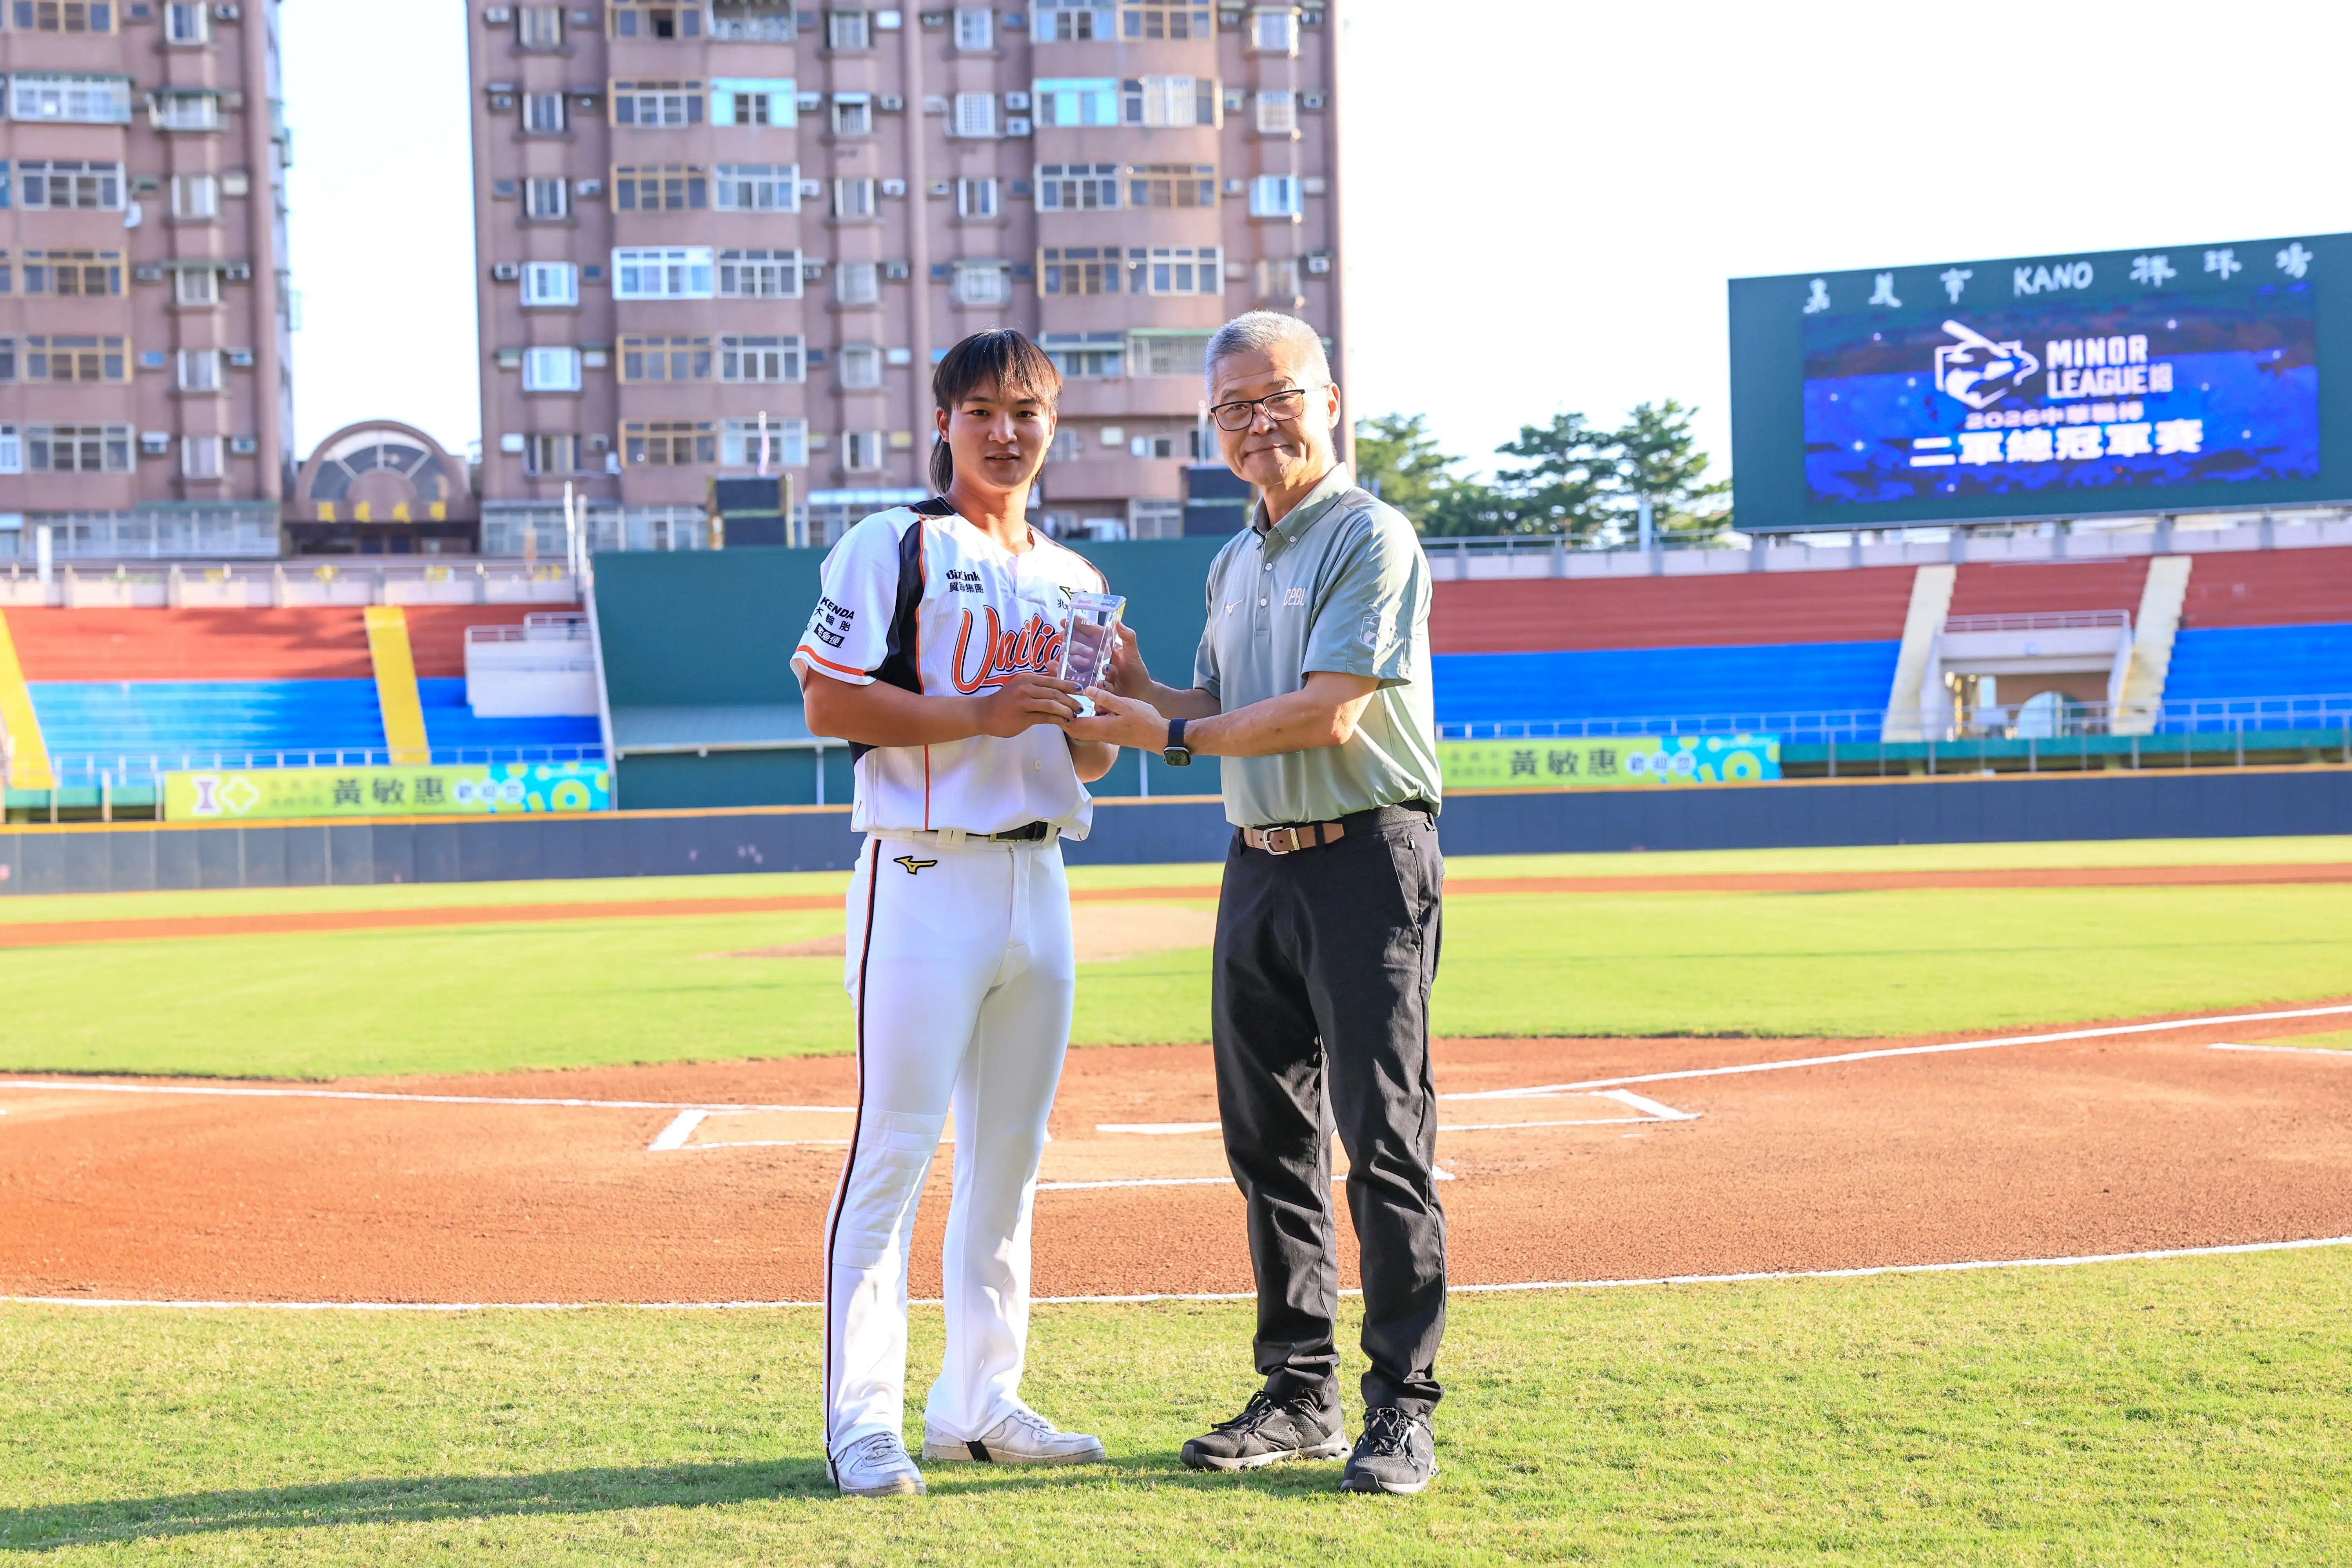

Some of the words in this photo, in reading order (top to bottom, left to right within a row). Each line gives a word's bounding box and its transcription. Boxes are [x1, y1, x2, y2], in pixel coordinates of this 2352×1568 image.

[2013, 261, 2093, 296] KANO
[2046, 335, 2148, 369] MINOR
[2047, 365, 2149, 399] LEAGUE
[946, 569, 981, 581] BizLink
[820, 597, 855, 620] KENDA
[1283, 588, 1306, 606] CPBL
[817, 626, 842, 646] 宅急便
[1509, 748, 1619, 778] 黃敏惠
[332, 776, 447, 808] 黃敏惠
